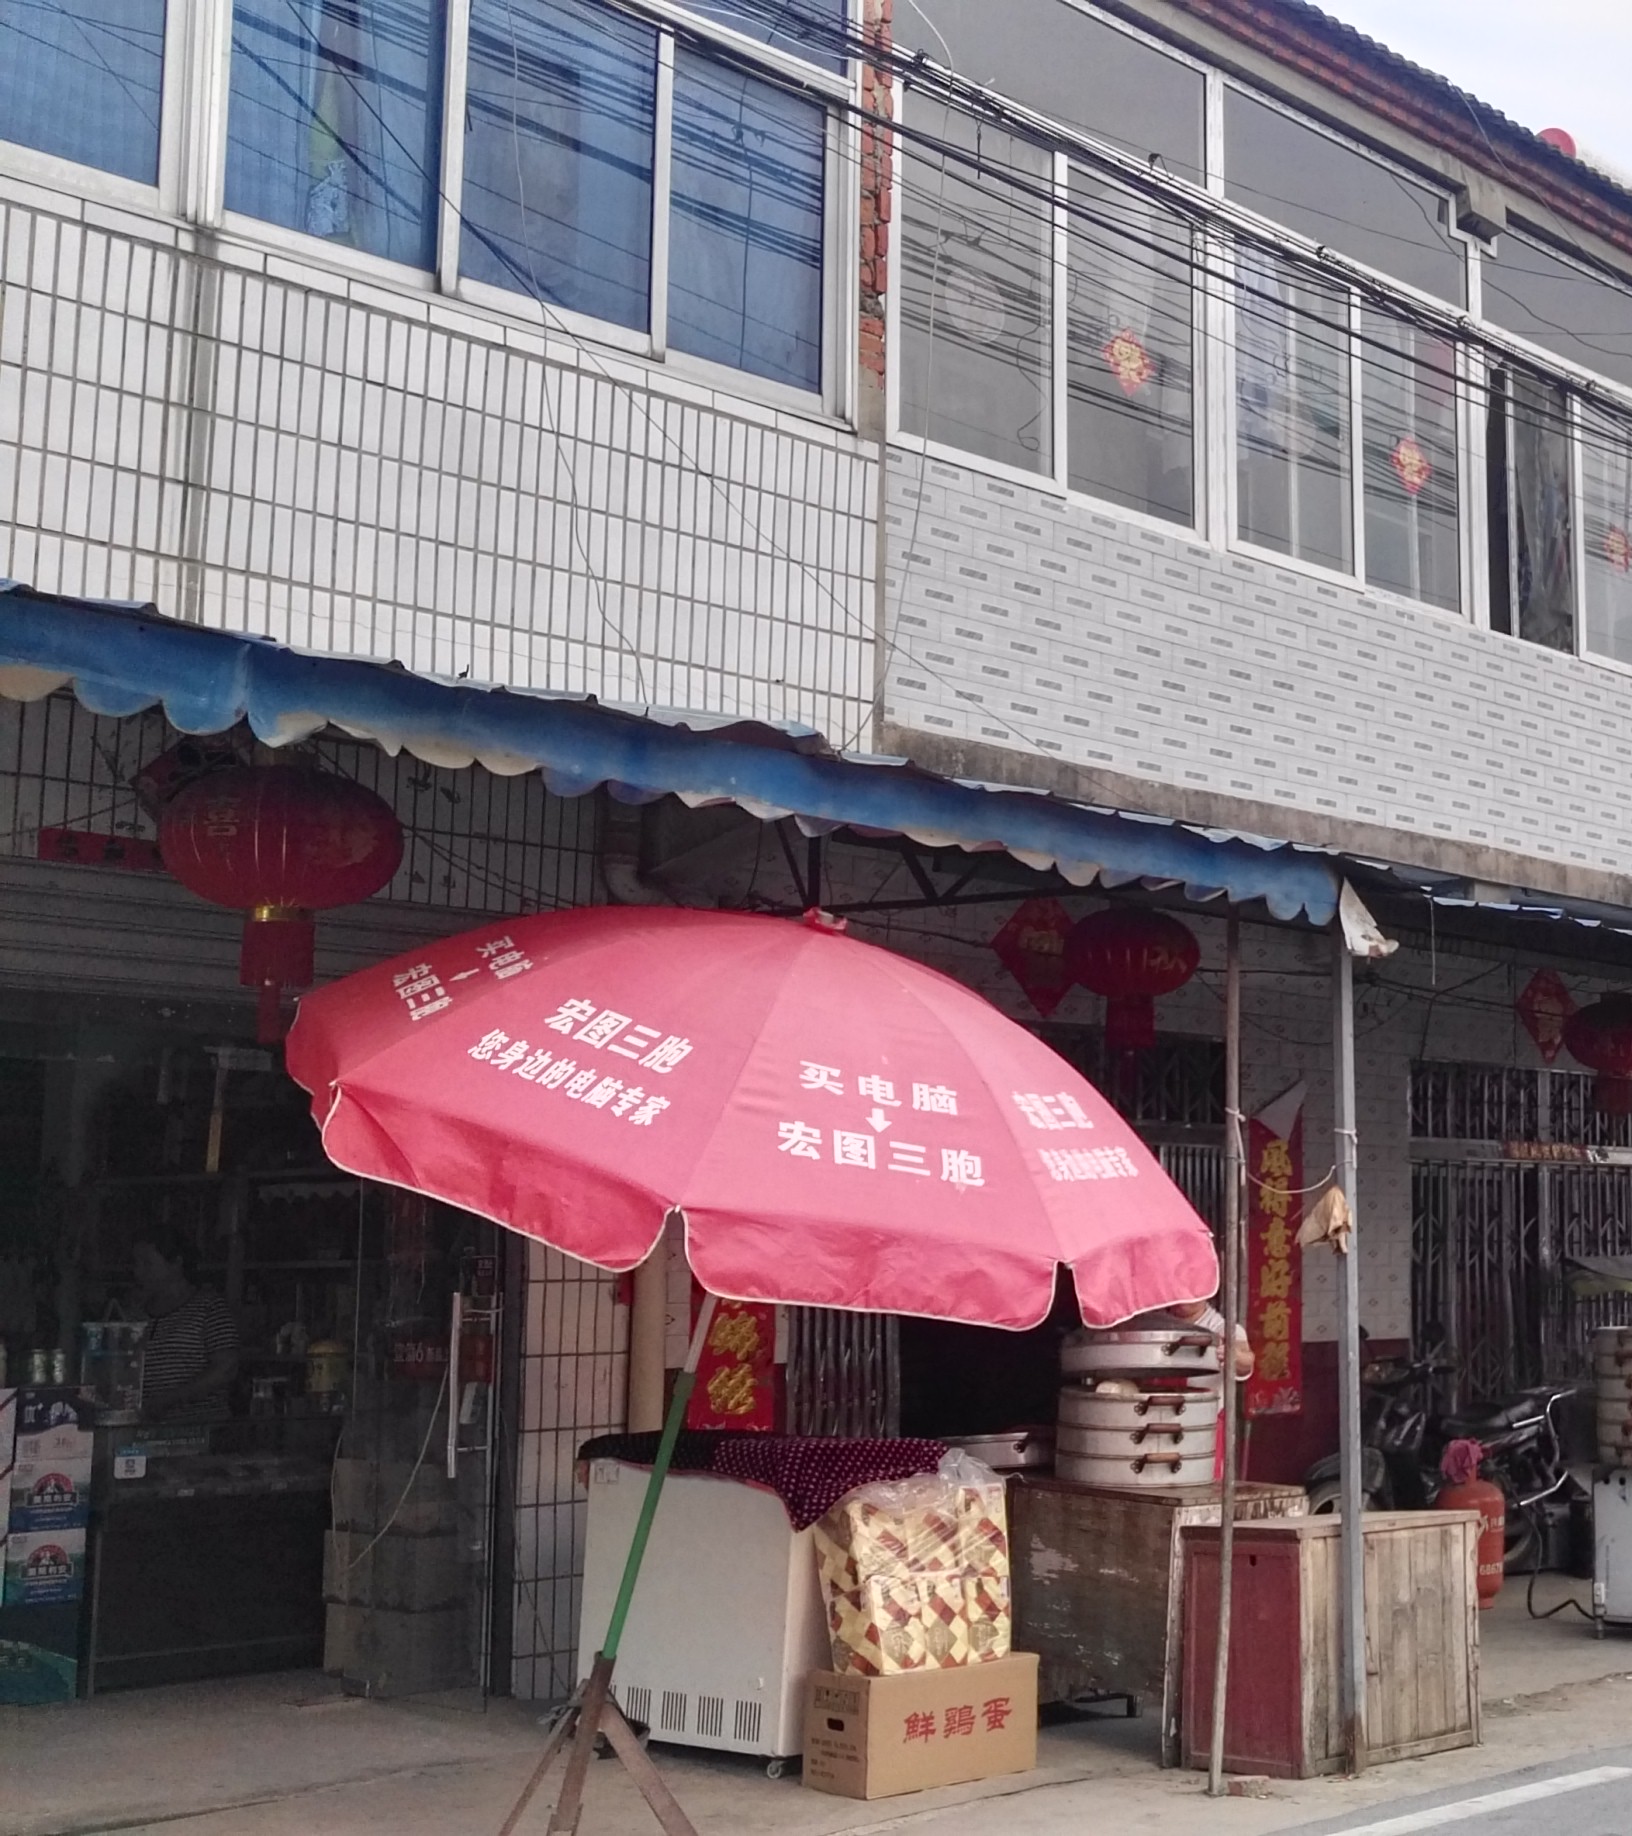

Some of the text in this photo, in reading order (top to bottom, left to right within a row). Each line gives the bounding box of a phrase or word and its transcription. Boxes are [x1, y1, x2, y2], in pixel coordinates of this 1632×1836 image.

[543, 998, 694, 1075] 宏图三胞
[467, 1029, 671, 1126] 您身边的电脑专家
[799, 1060, 958, 1116] 买电脑
[777, 1120, 985, 1187] 宏图三胞
